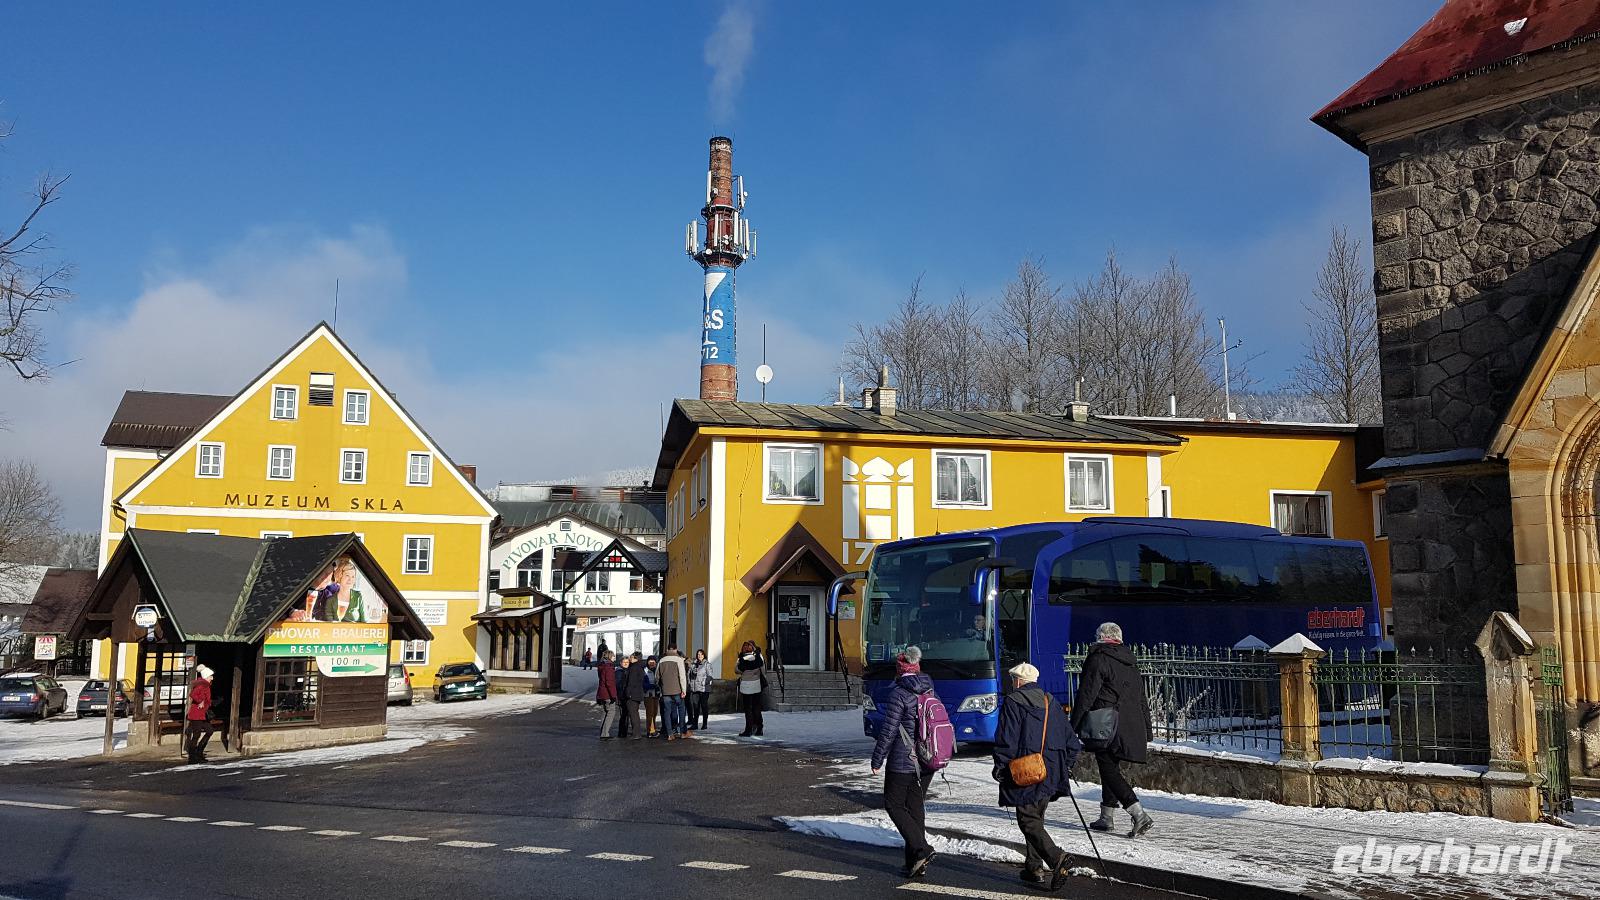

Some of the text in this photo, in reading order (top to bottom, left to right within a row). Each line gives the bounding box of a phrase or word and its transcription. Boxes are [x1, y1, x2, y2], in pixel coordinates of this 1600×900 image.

[224, 493, 404, 511] MUZEUM SKLA
[502, 532, 558, 570] PIVOVAR
[1307, 607, 1365, 629] eberhardt
[268, 627, 321, 639] PIVOVAR
[332, 627, 386, 639] BRAUEREI
[290, 645, 366, 654] RESTAURANT
[332, 658, 349, 666] 100
